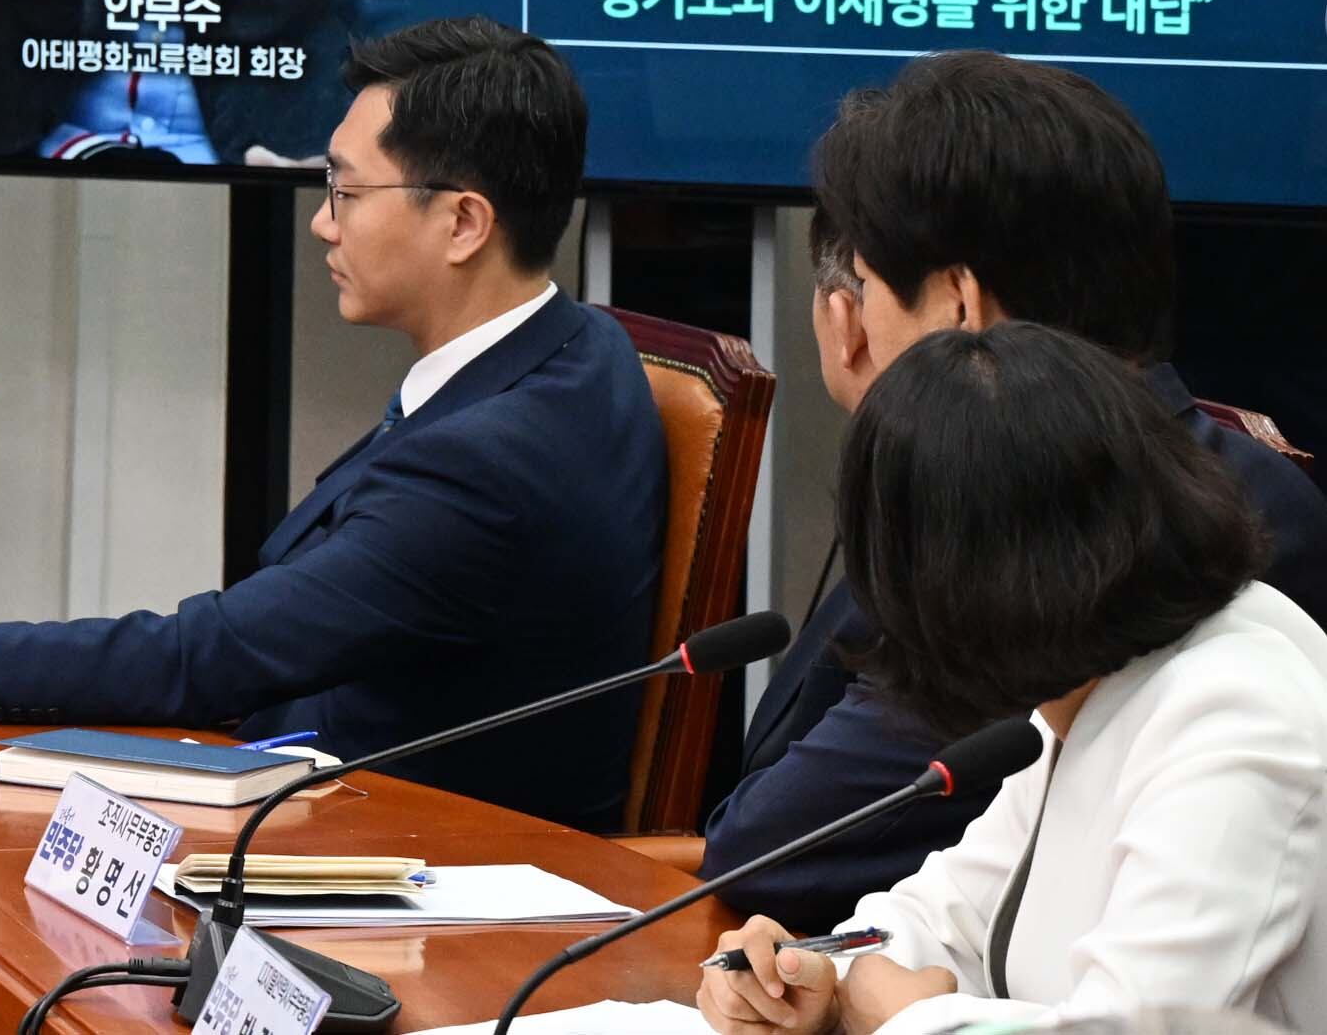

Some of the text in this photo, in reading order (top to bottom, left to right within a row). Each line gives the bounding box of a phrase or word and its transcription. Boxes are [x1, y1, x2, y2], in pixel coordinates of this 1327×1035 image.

[21, 38, 307, 80] 아태평화교류협회 회장
[39, 820, 85, 872] 민주당
[98, 799, 170, 857] 조직사무부총장
